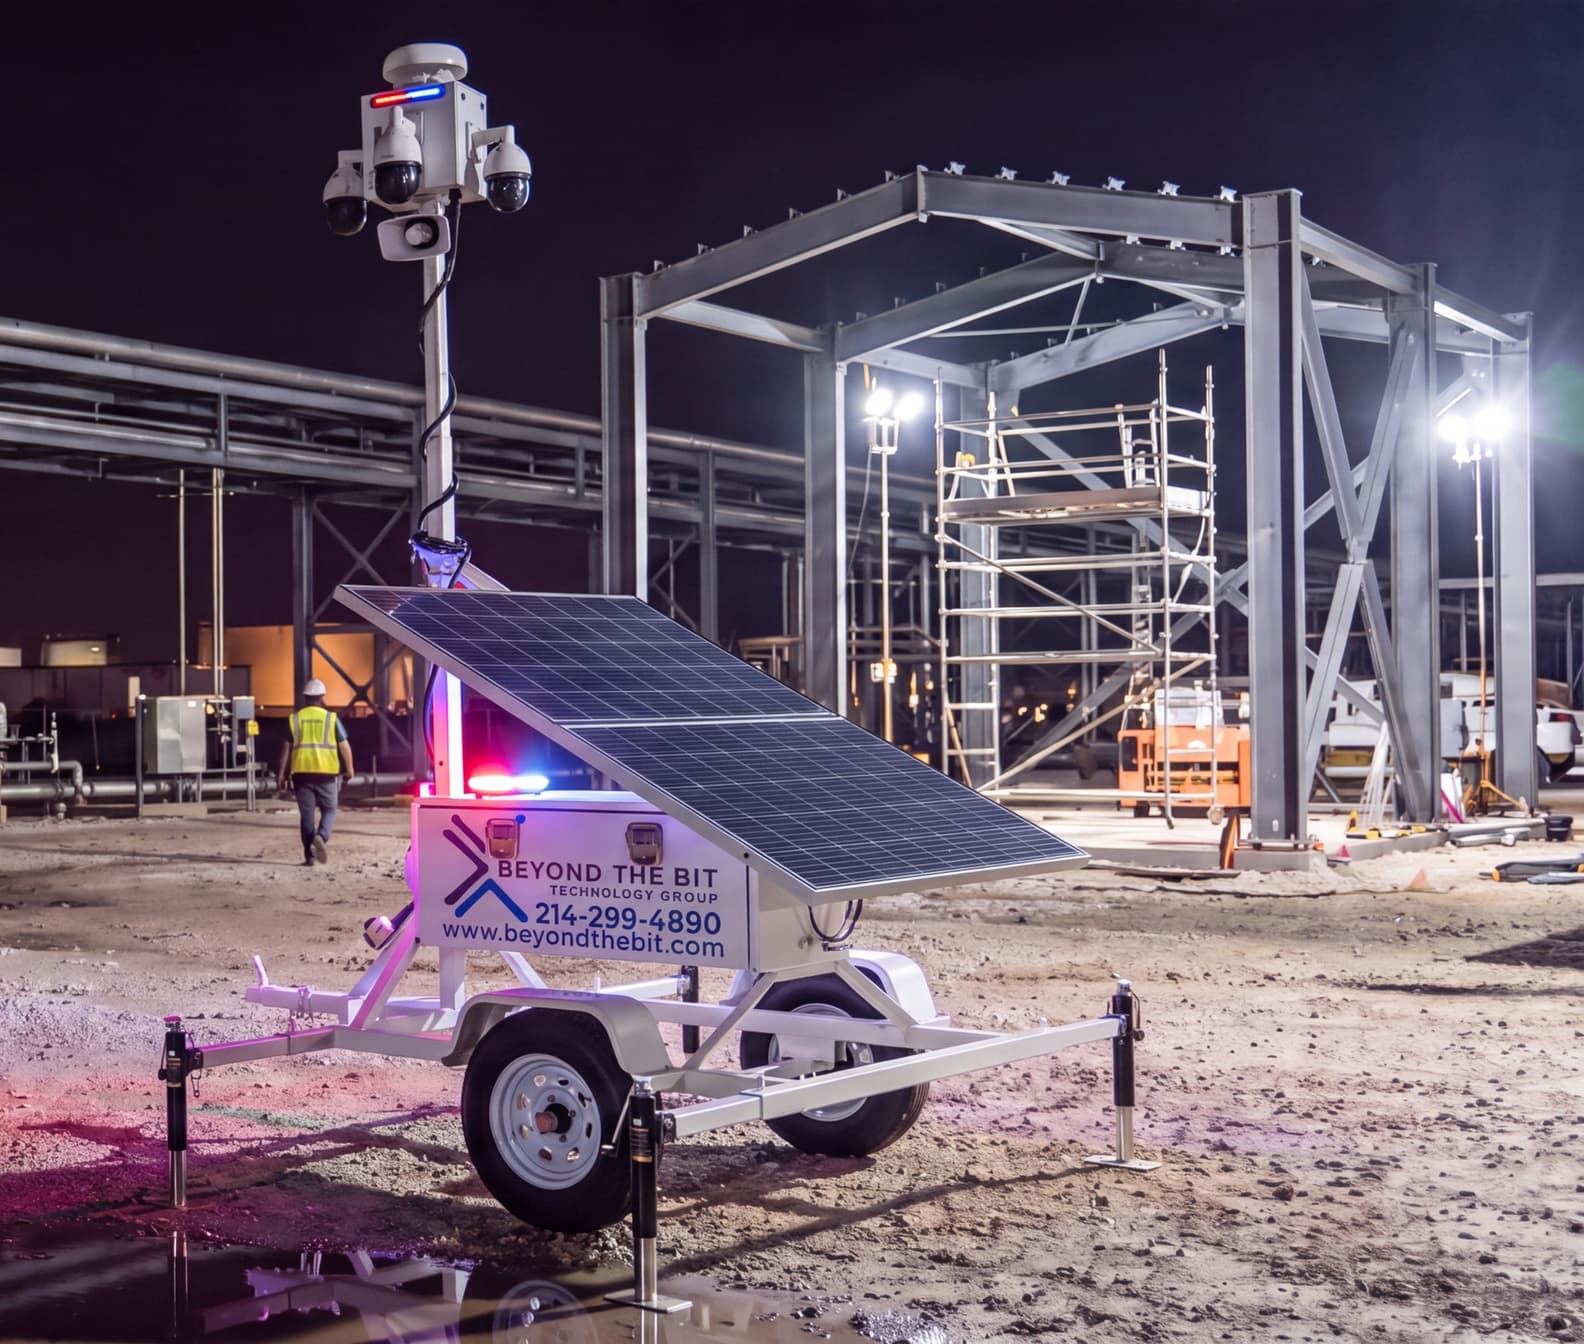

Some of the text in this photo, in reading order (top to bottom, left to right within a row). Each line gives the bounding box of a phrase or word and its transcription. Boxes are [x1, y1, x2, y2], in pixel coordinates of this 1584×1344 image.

[498, 860, 718, 888] BEYOND THE BIT
[550, 885, 718, 904] TECHNOLOGY GROUP
[535, 902, 721, 936] 214-299-4890
[443, 922, 725, 958] www.beyondthebit.com
